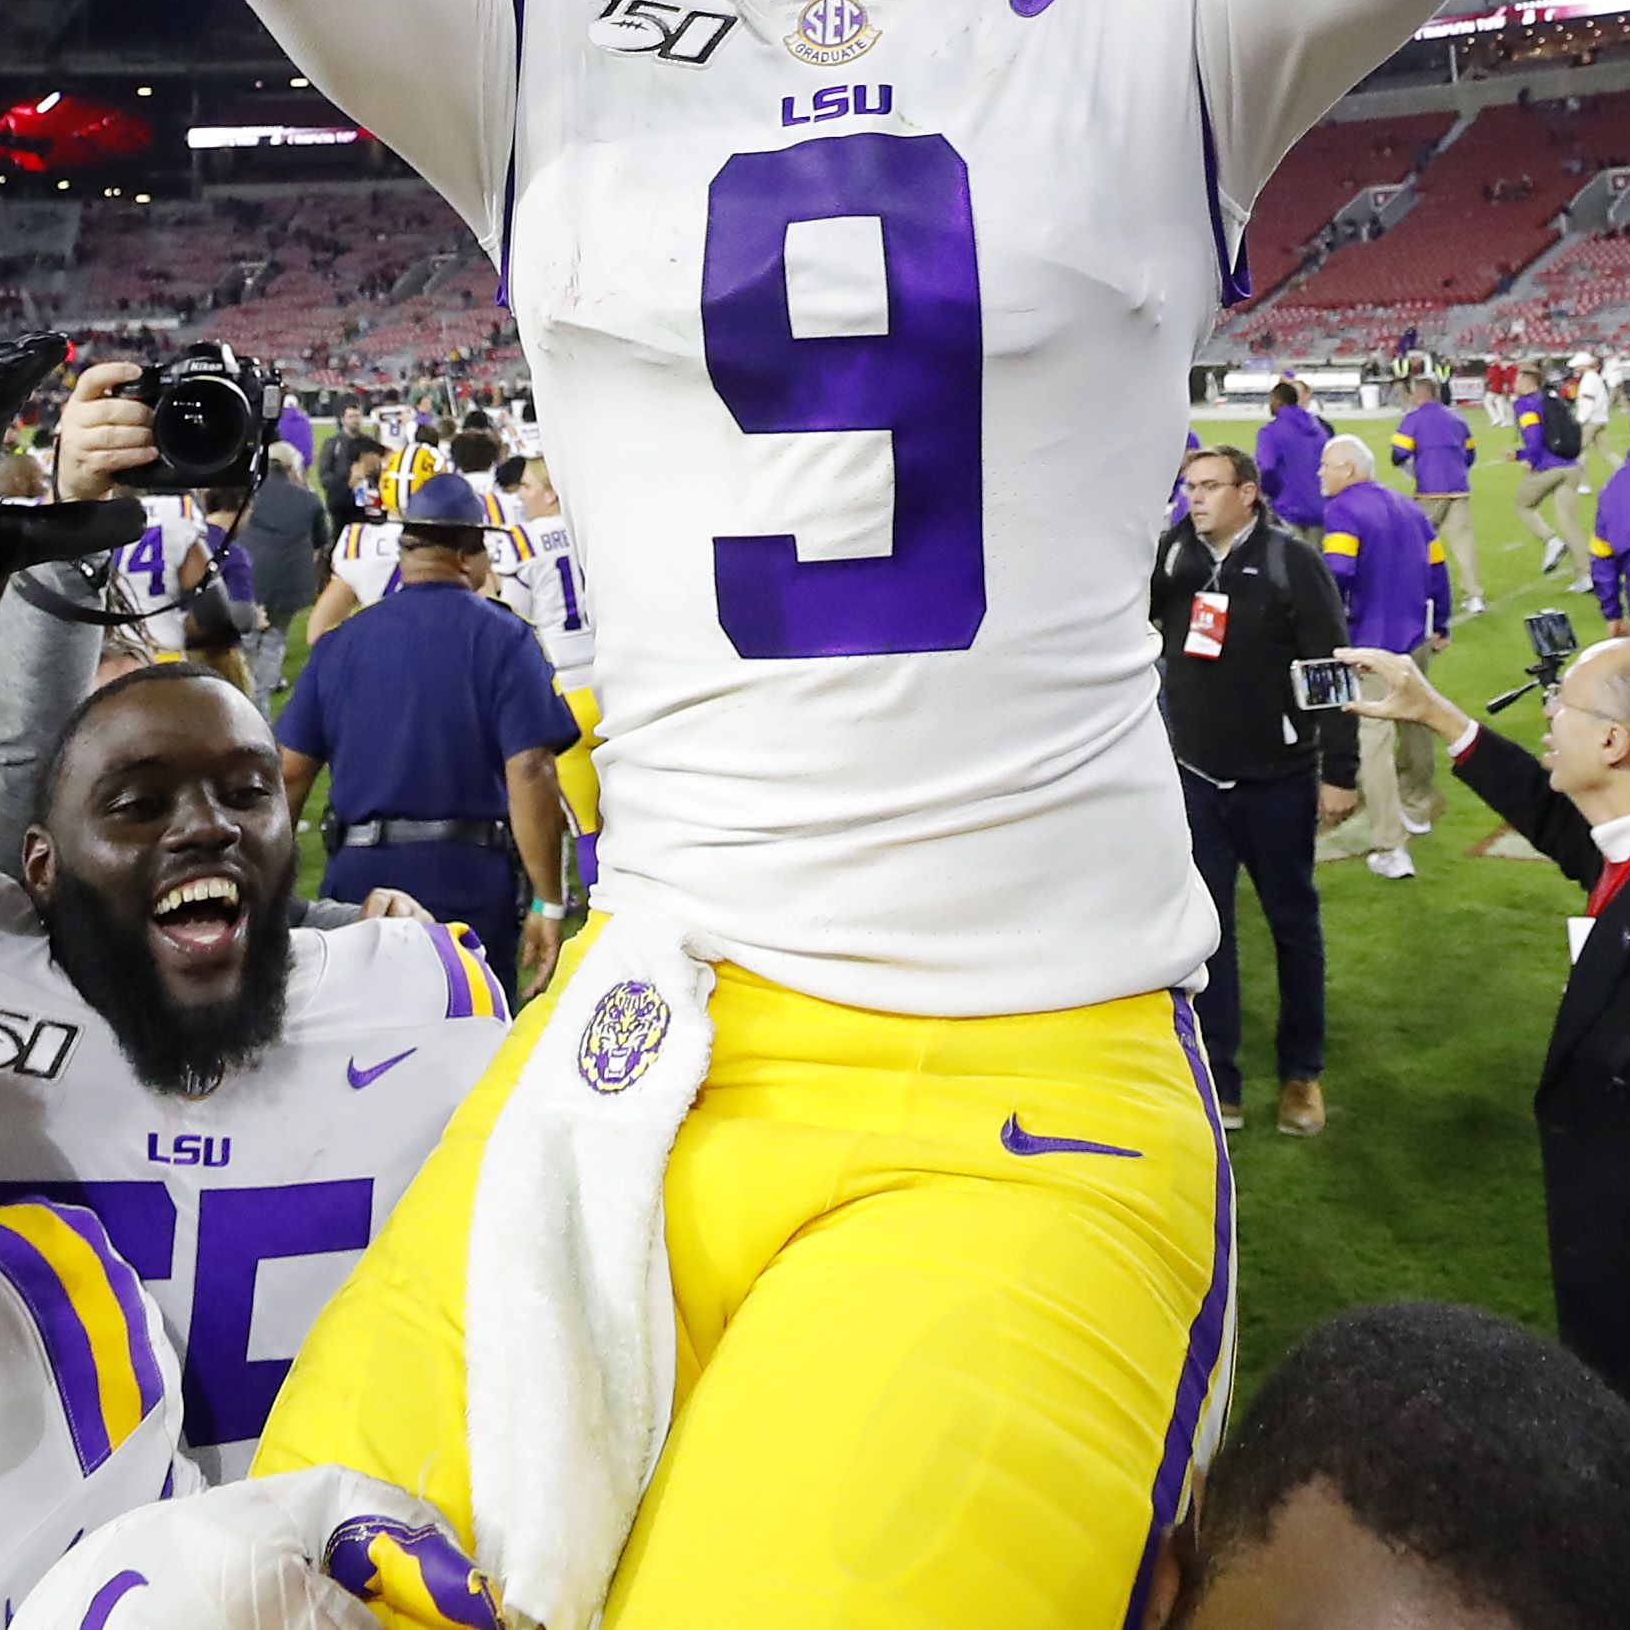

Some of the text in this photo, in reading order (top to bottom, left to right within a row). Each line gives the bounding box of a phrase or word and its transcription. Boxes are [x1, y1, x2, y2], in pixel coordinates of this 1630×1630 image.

[804, 0, 864, 47] SEC
[793, 38, 868, 64] GRADUATE
[781, 84, 894, 127] LSU
[188, 360, 224, 372] Nikon
[701, 132, 988, 660] 9
[147, 1132, 232, 1168] LSU
